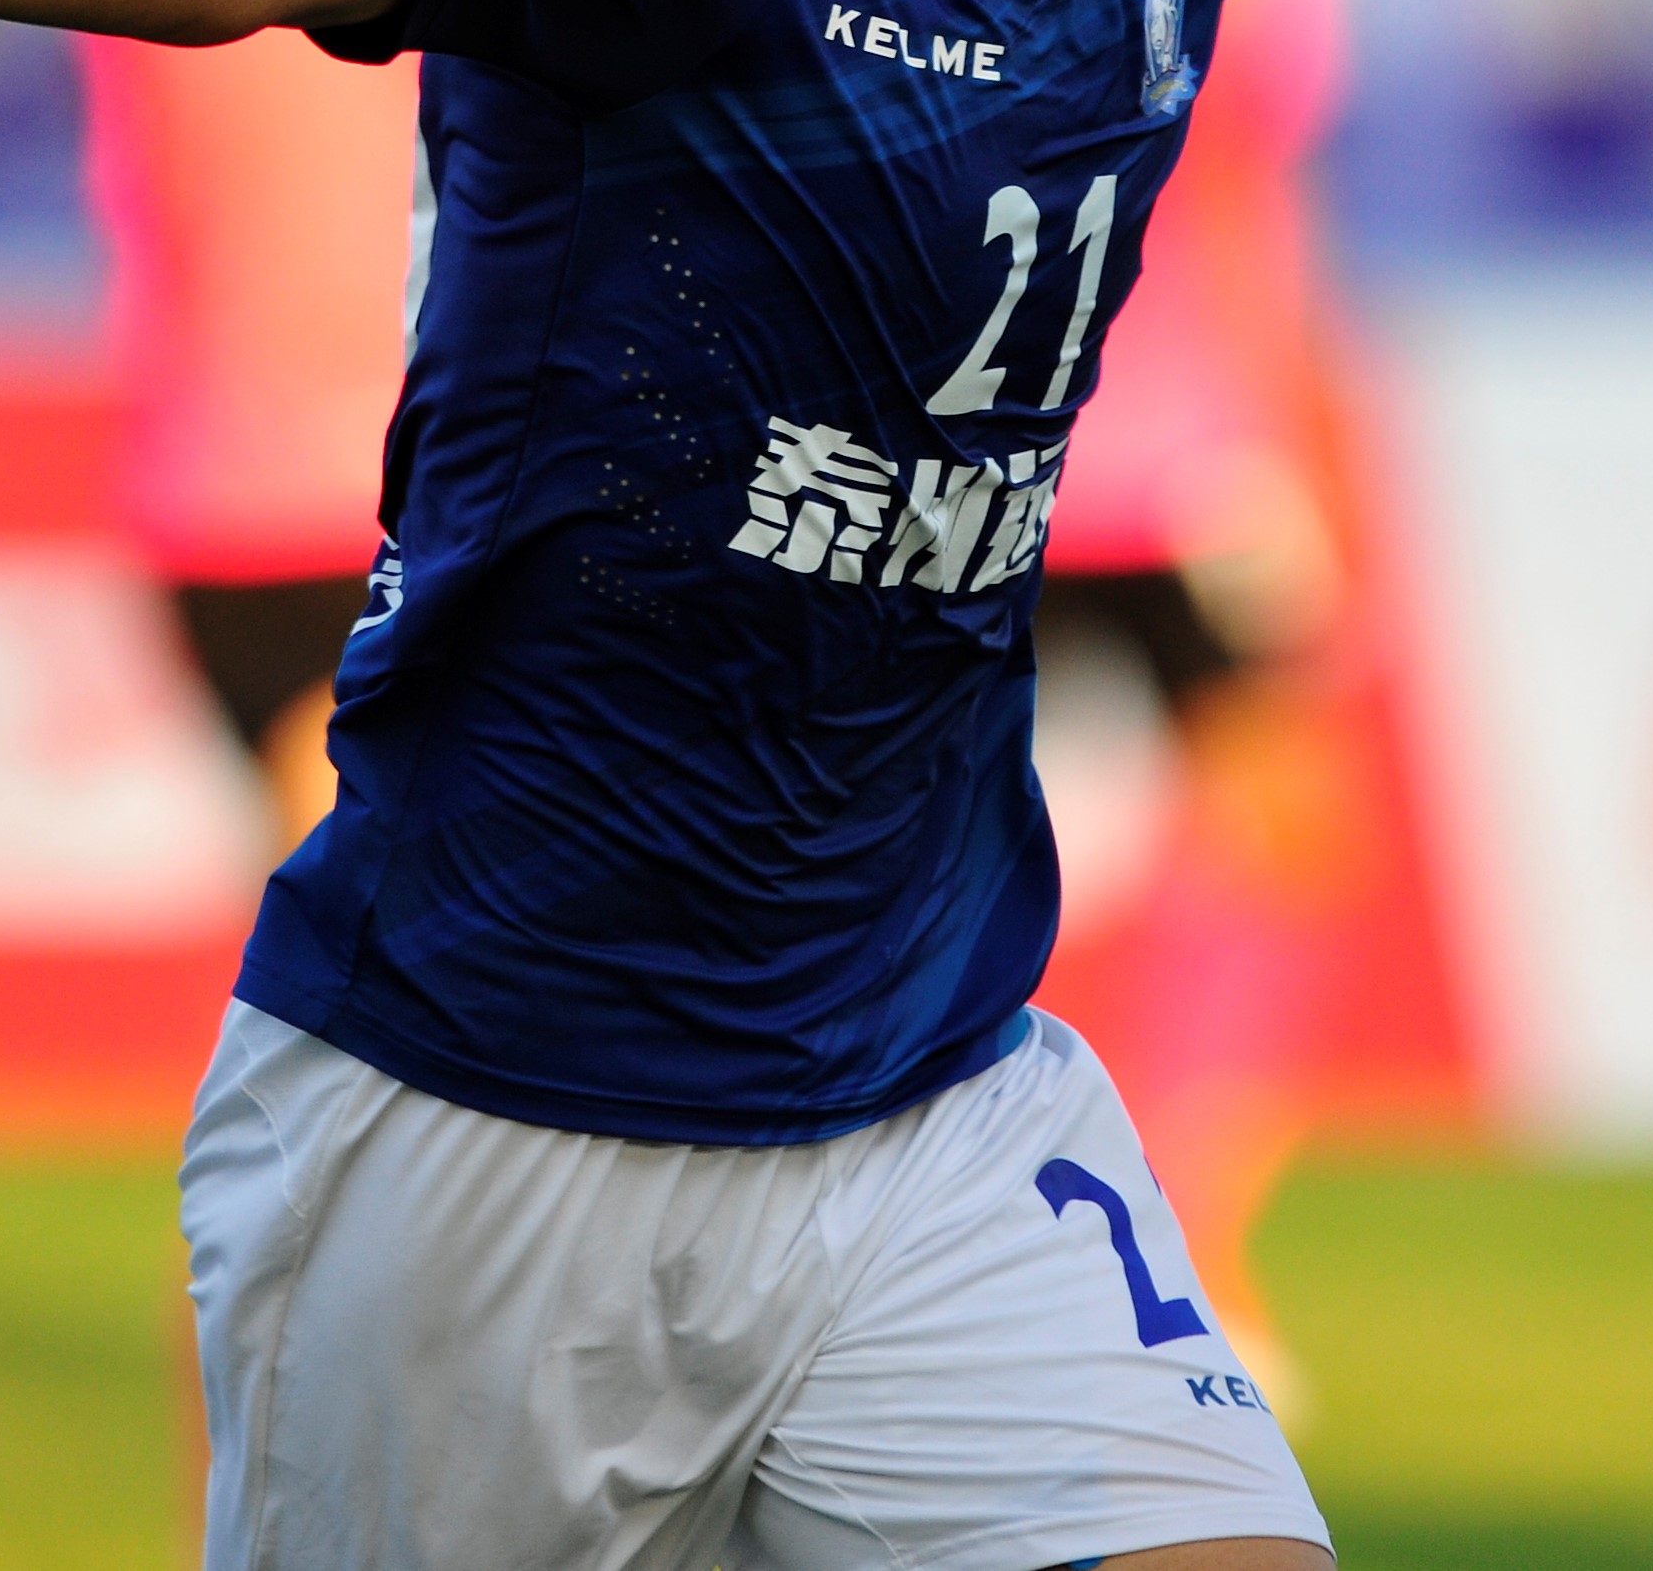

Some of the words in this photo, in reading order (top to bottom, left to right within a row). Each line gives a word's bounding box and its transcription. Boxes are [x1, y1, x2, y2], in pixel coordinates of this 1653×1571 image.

[824, 3, 1005, 81] KELME
[925, 174, 1118, 416] 21
[1035, 1155, 1210, 1348] 2
